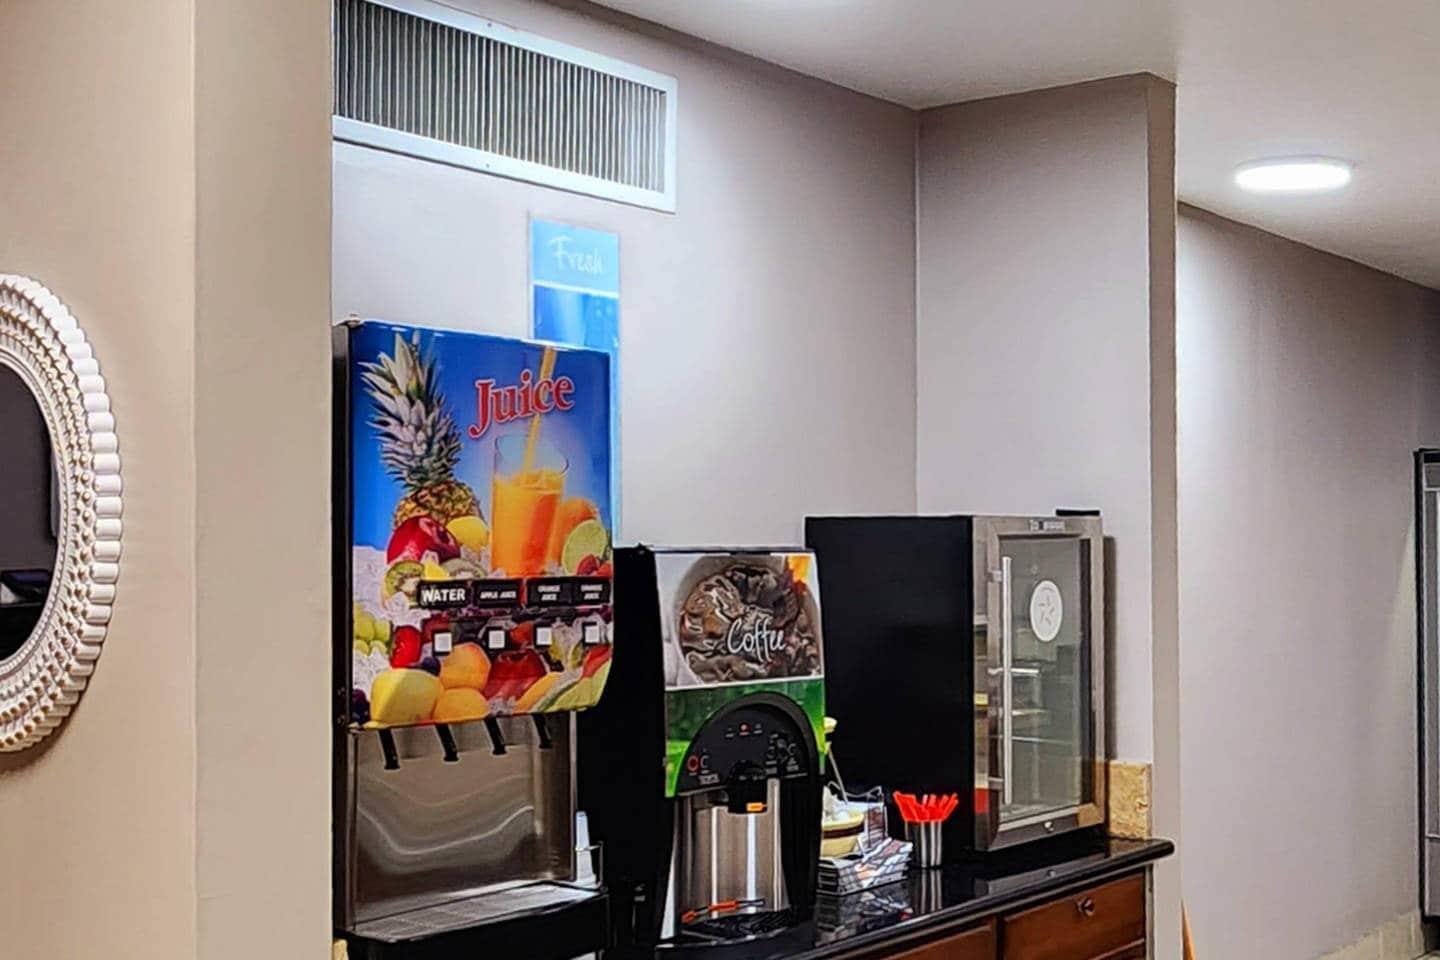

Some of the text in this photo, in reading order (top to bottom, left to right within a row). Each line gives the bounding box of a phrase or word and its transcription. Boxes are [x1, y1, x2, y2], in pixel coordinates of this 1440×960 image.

[546, 235, 605, 274] Fresh
[467, 368, 576, 439] Juice
[420, 588, 466, 602] WATER
[727, 616, 787, 663] Coffee
